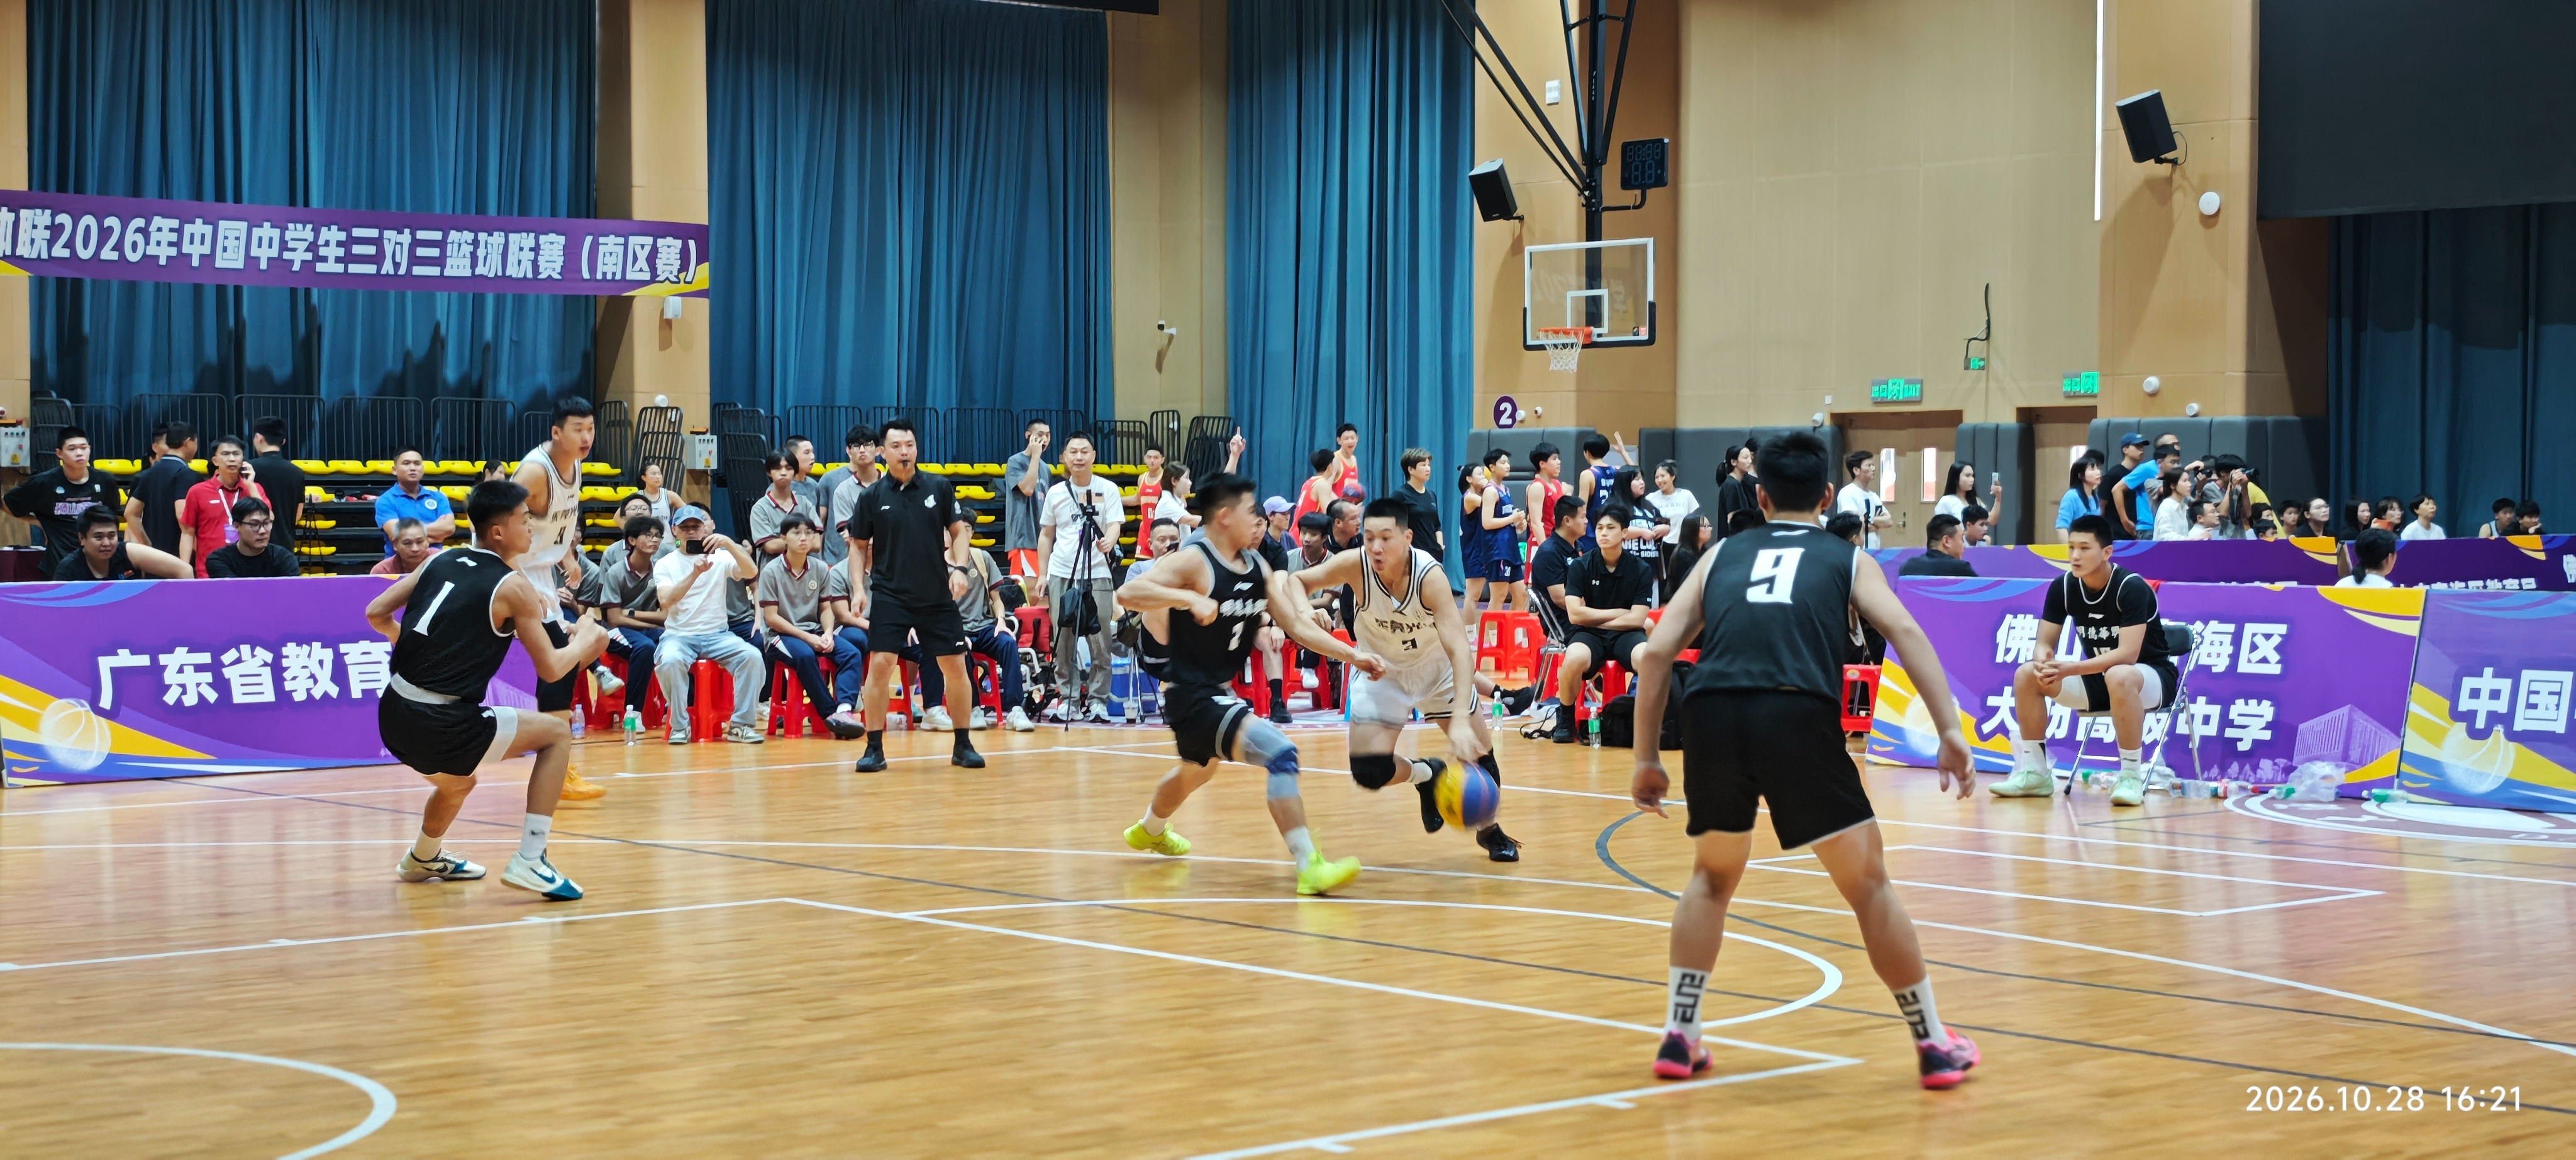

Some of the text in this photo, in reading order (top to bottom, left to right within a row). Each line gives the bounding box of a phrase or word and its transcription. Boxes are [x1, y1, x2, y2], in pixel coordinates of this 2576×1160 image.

[1499, 402, 1513, 425] 2
[1746, 547, 1806, 604] 9
[413, 581, 455, 637] 1
[1996, 614, 2287, 675] 佛山海区
[97, 640, 392, 710] 广东省教育
[2458, 667, 2576, 734] 中国
